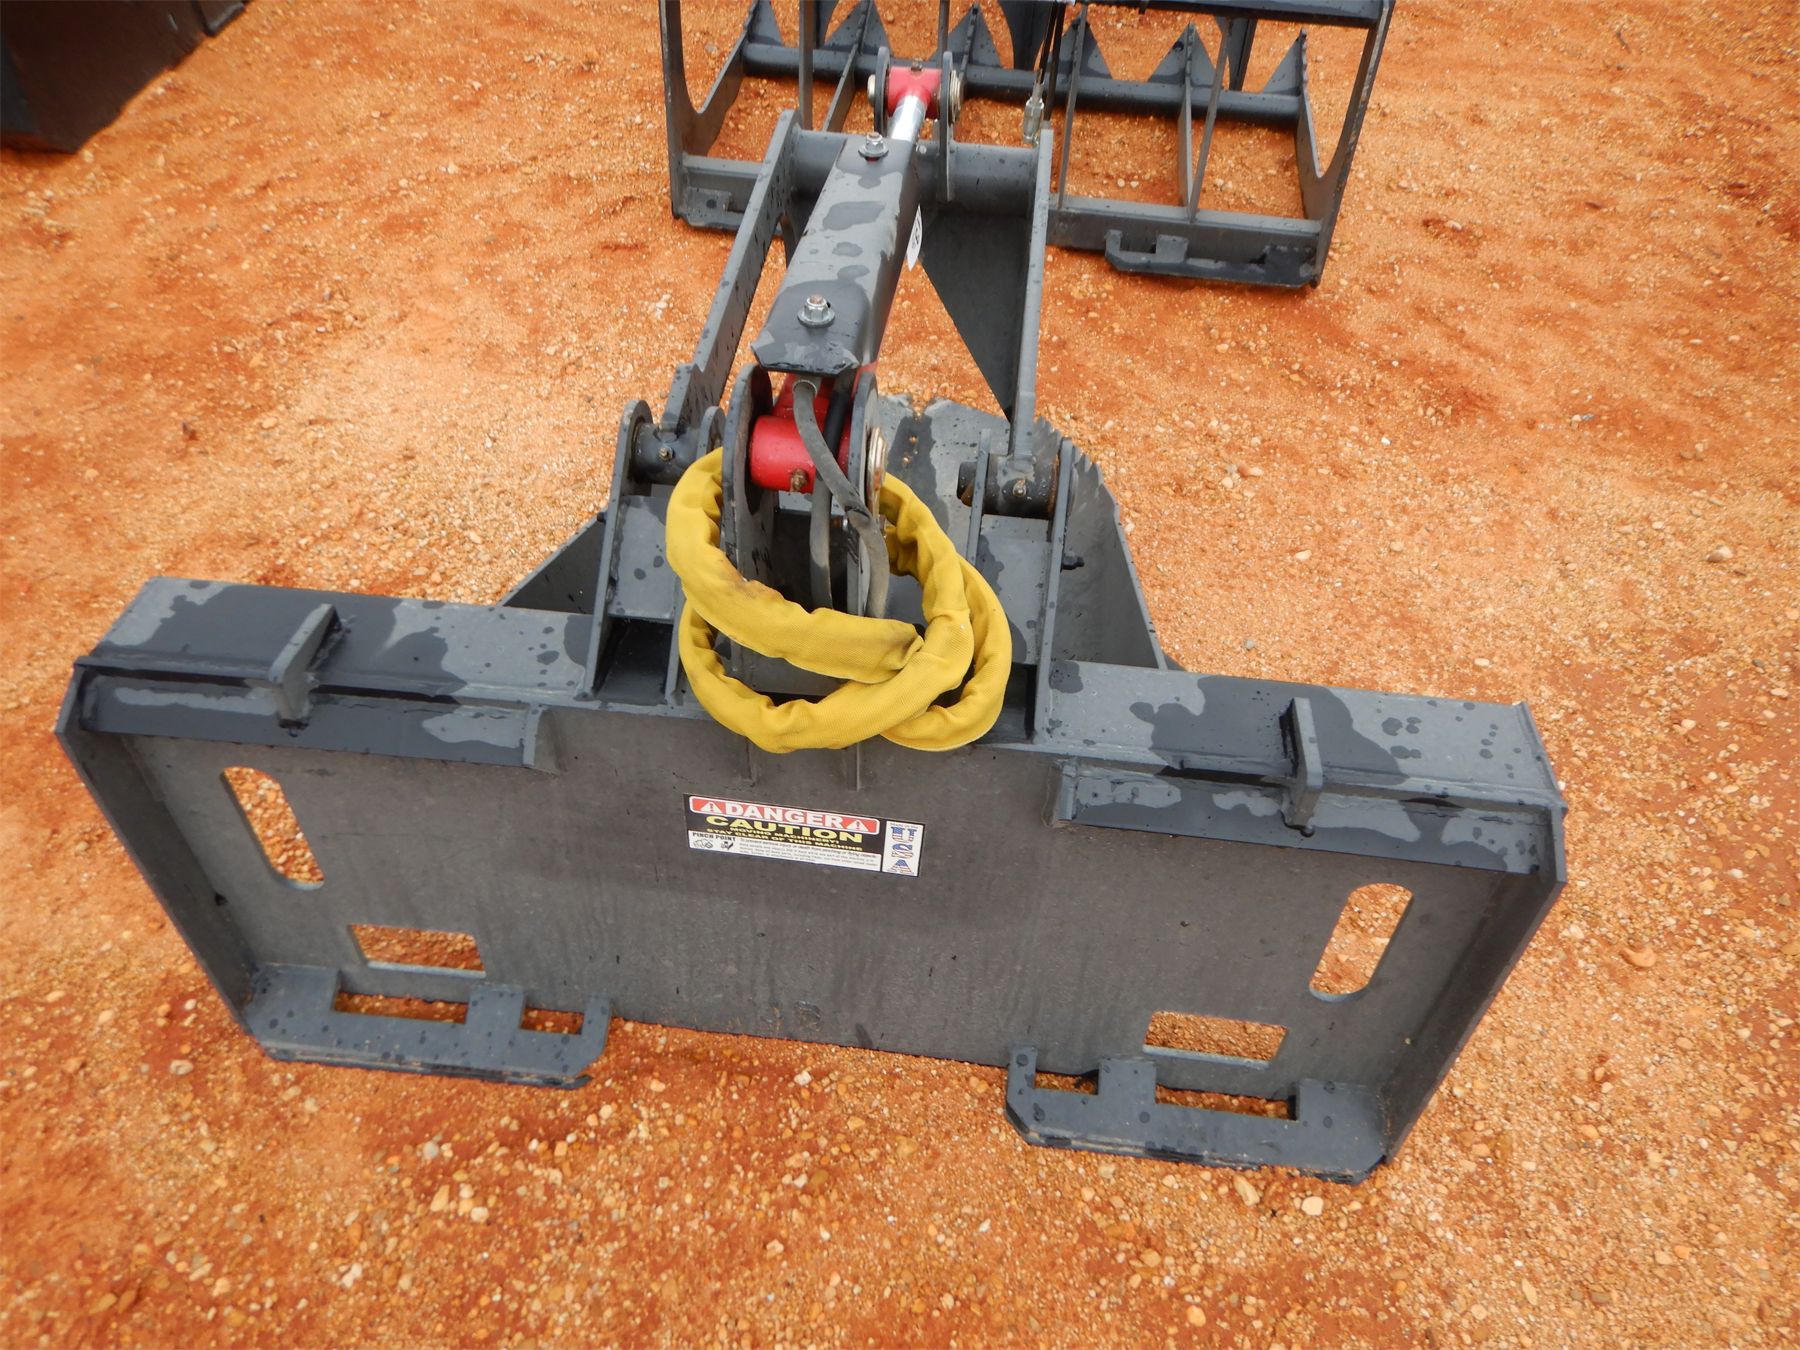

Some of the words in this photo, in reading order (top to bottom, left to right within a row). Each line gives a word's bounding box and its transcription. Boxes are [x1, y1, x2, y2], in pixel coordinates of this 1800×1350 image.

[725, 802, 844, 829] DANGER
[706, 816, 862, 843] CAUTION
[729, 827, 771, 836] MOVING
[815, 841, 863, 851] MACHINE
